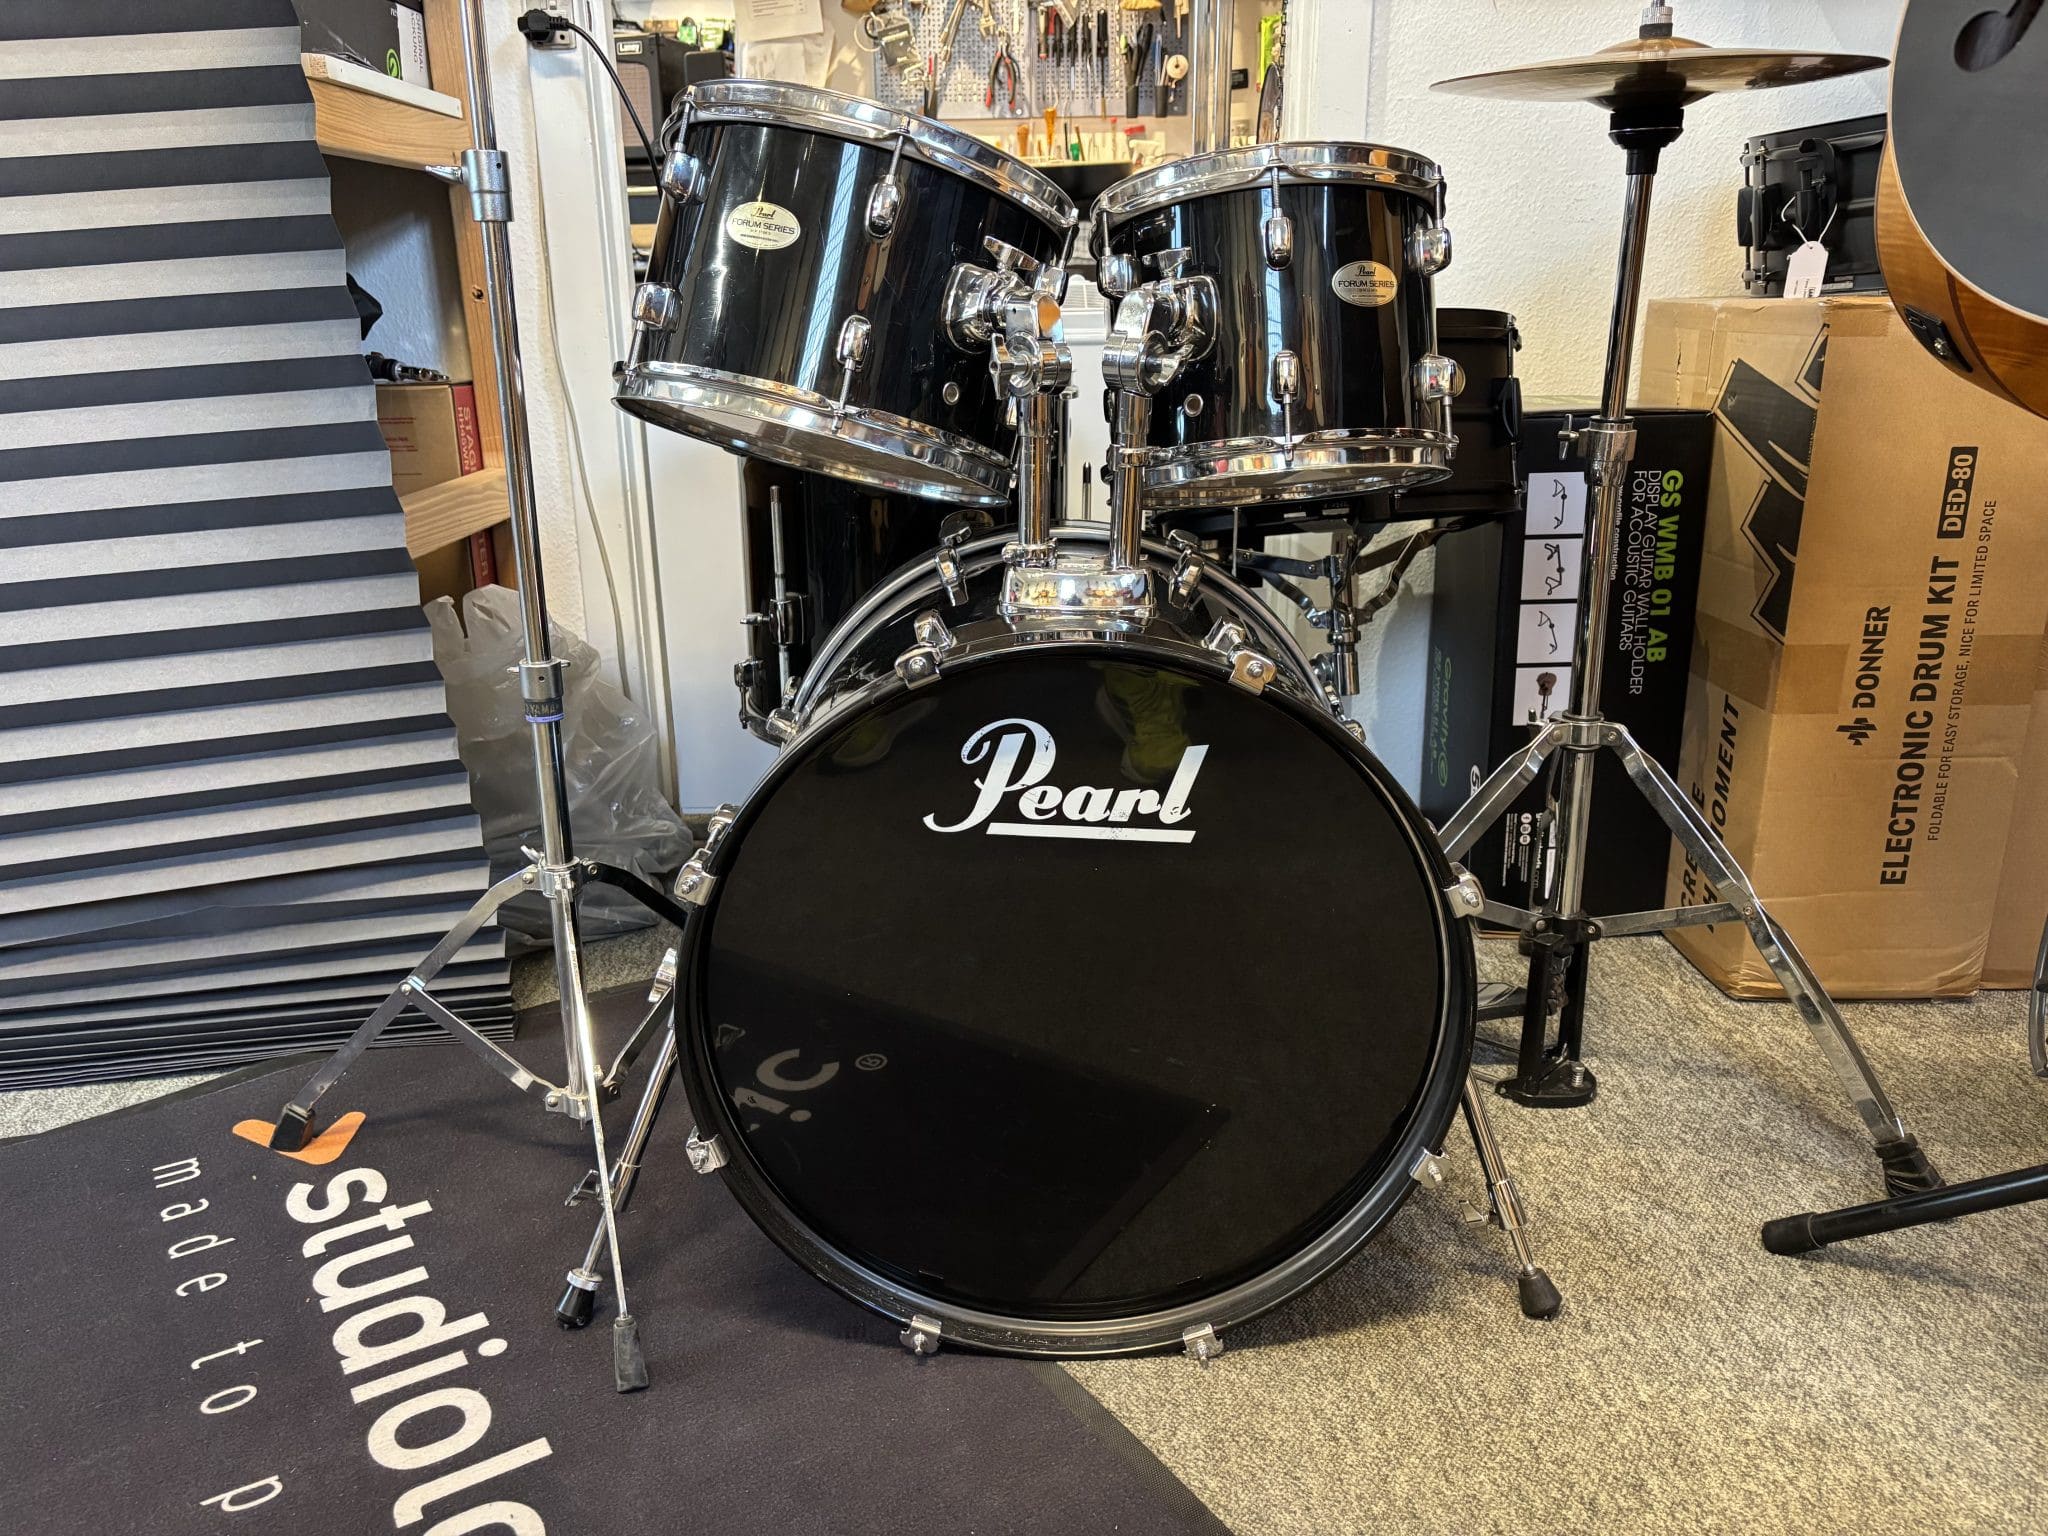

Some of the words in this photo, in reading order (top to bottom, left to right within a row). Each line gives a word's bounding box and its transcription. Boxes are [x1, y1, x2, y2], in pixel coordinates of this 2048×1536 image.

[731, 217, 761, 229] FORUM
[762, 222, 796, 235] SERIES
[1338, 280, 1368, 288] FORUM
[1369, 280, 1395, 288] SERIES
[1355, 264, 1377, 277] Pearl
[1632, 470, 1648, 503] FOR
[1644, 470, 1662, 531] DISPLAY
[1660, 469, 1684, 508] GS
[1942, 453, 1974, 532] DED-80
[1624, 506, 1644, 586] ACOUSTIC
[1653, 514, 1680, 581] WMB
[1979, 500, 1997, 542] SPACE
[1638, 534, 1656, 589] GUITAR
[1927, 556, 1959, 604] KIT
[1970, 545, 1988, 596] LIMITED
[1619, 589, 1637, 651] GUITARS
[1634, 592, 1650, 632] WALL
[1650, 588, 1672, 616] 01
[1965, 600, 1979, 624] FOR
[1629, 636, 1648, 695] HOLDER
[1646, 627, 1668, 662] AB
[1852, 606, 1891, 708] DONNER
[1910, 615, 1950, 701] DRUM
[1959, 628, 1975, 656] NICE
[1948, 660, 1970, 720] STORAGE,
[1943, 723, 1957, 752] EASY
[923, 718, 1209, 834] Pearl
[1938, 754, 1952, 779] FOR
[1880, 710, 1933, 885] ELECTRONIC
[1927, 781, 1949, 841] FOLDABLE
[152, 1157, 236, 1297] made
[191, 1338, 264, 1415] to
